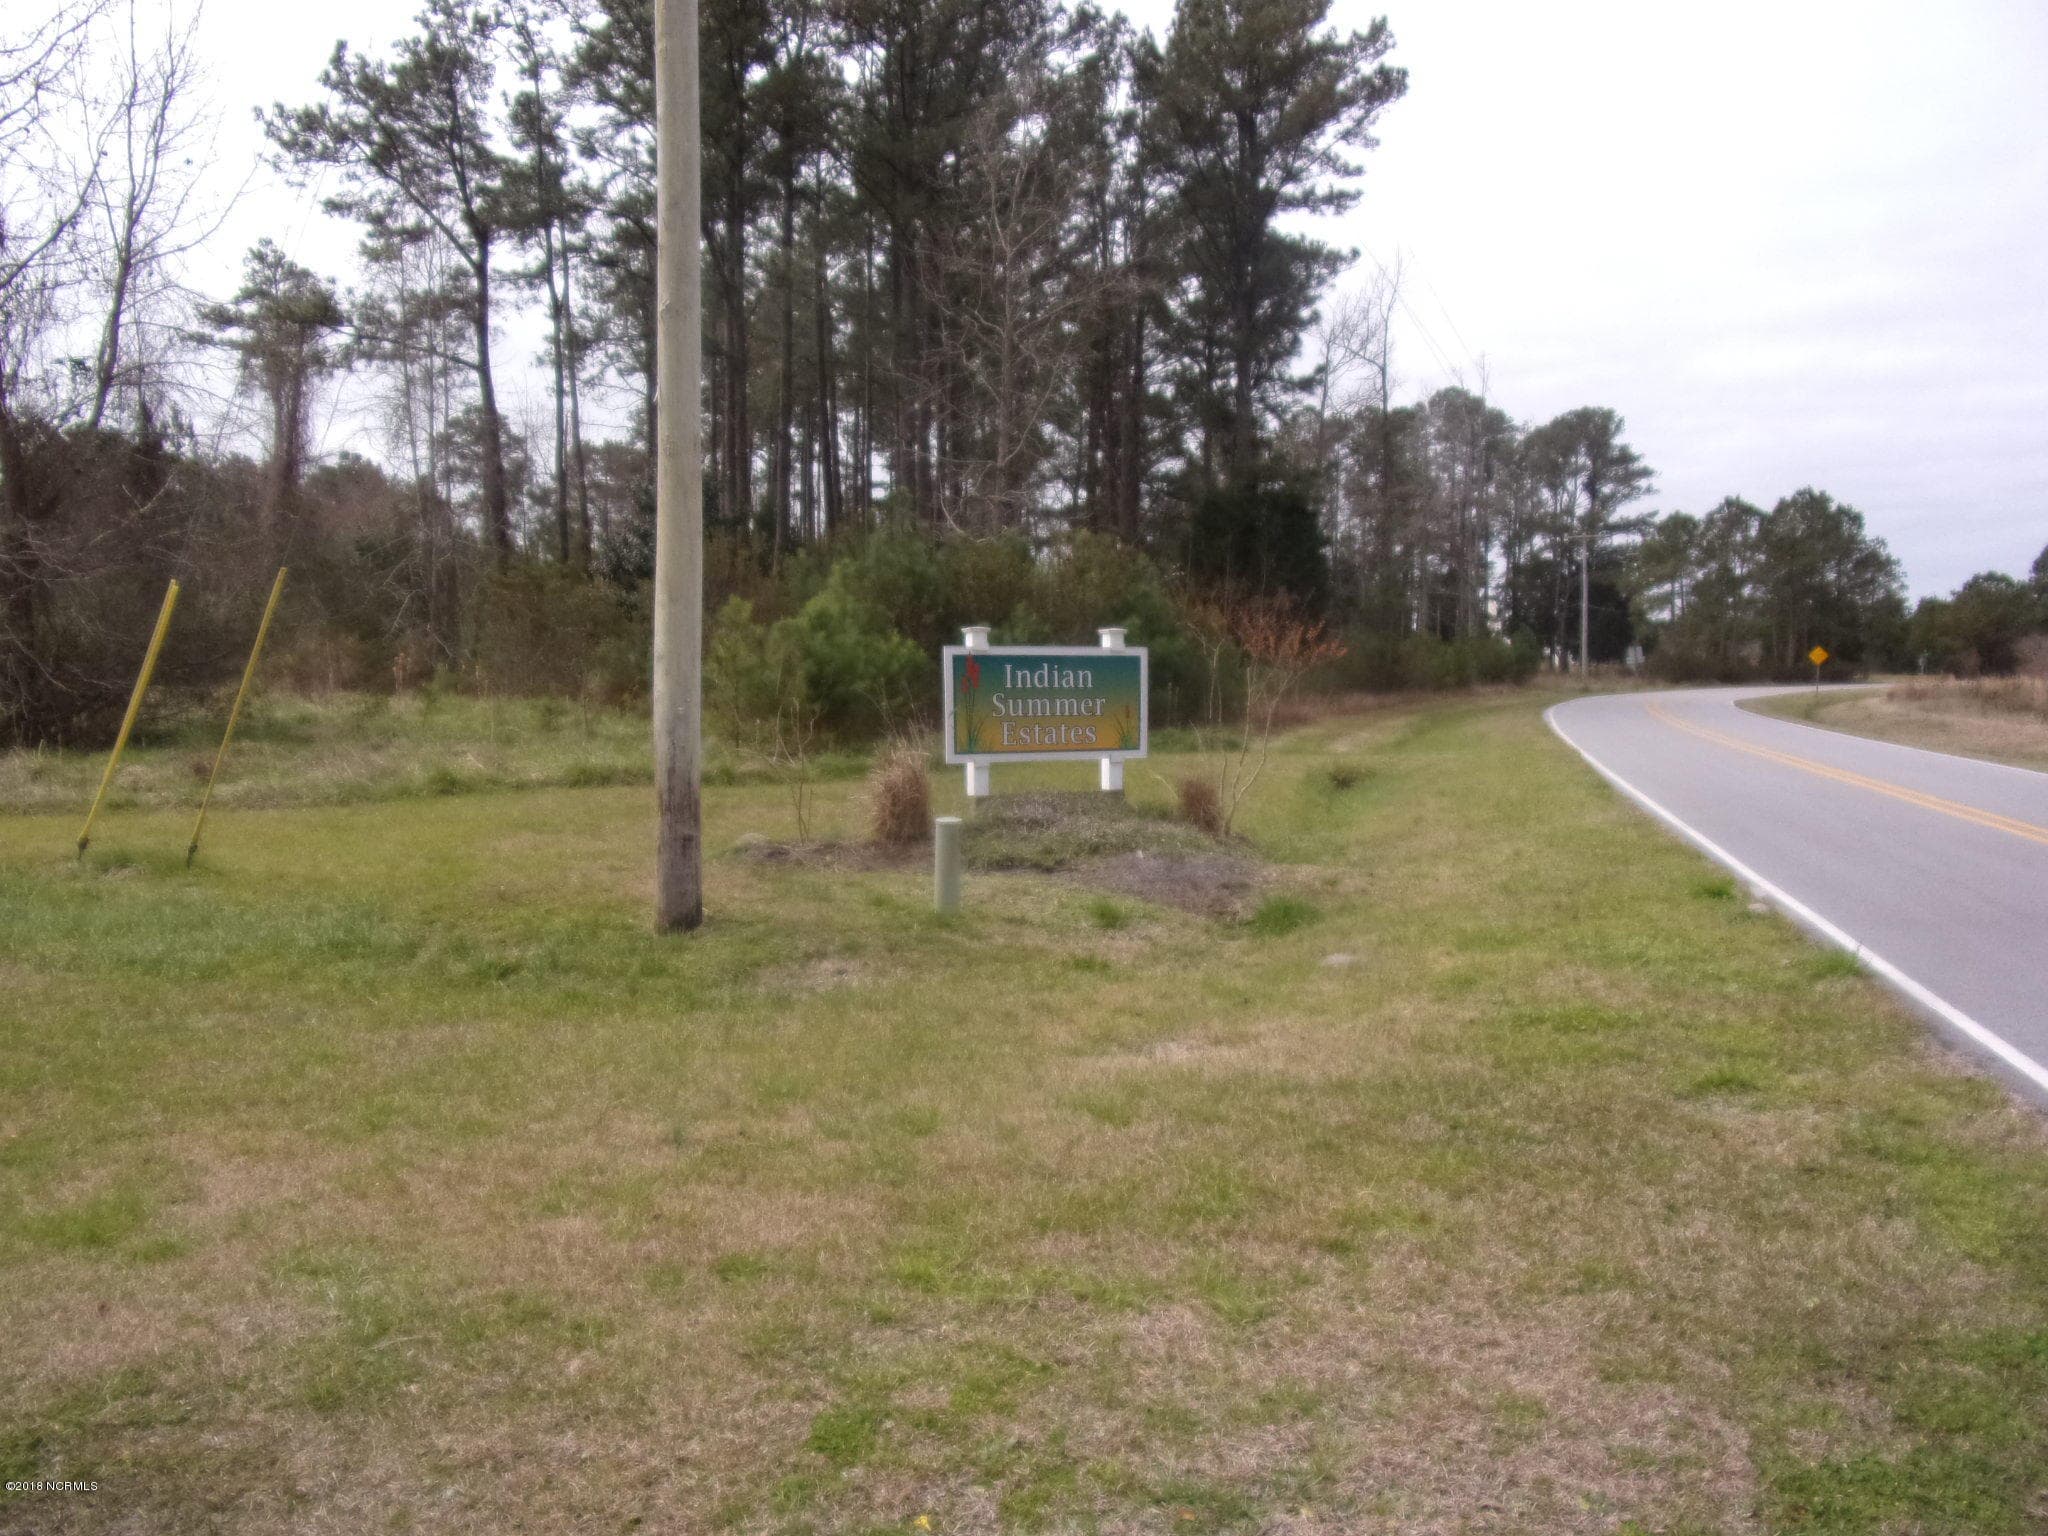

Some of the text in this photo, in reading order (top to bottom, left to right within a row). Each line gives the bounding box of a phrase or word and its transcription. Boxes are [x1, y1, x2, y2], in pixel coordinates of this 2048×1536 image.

[1004, 663, 1094, 688] Indian
[992, 692, 1106, 717] Summer
[1001, 721, 1097, 745] Estates
